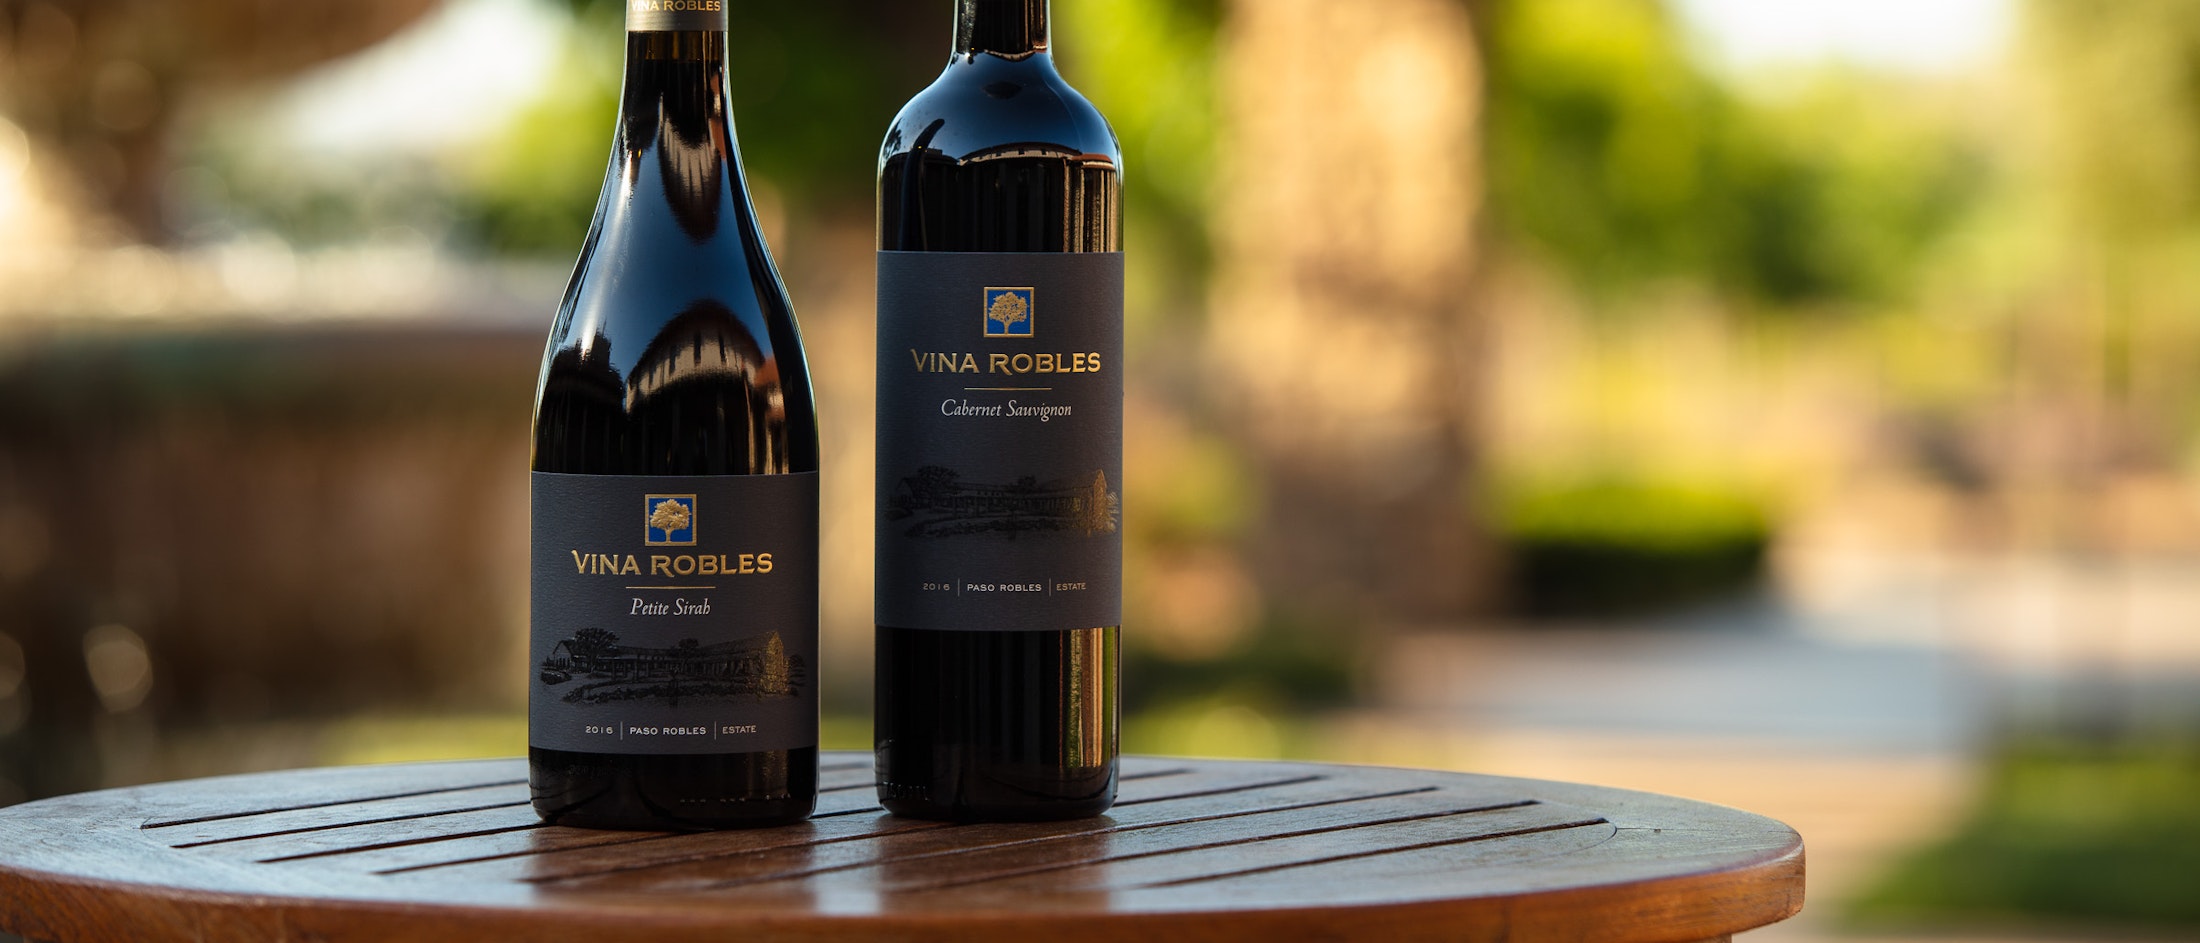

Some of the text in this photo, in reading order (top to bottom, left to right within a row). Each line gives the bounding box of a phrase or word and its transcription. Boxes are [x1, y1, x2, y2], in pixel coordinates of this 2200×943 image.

[631, 0, 721, 12] VINA ROBLES
[910, 348, 1101, 376] VINA ROBLES
[941, 398, 1072, 423] Cabernet Sauvignon
[570, 549, 773, 578] VINA ROBLES
[922, 582, 1086, 592] 2016 PASO ROBLES ESTATE
[630, 597, 711, 616] Petite Sirah
[585, 725, 757, 736] 2016 PASO ROBLES ESTATE
